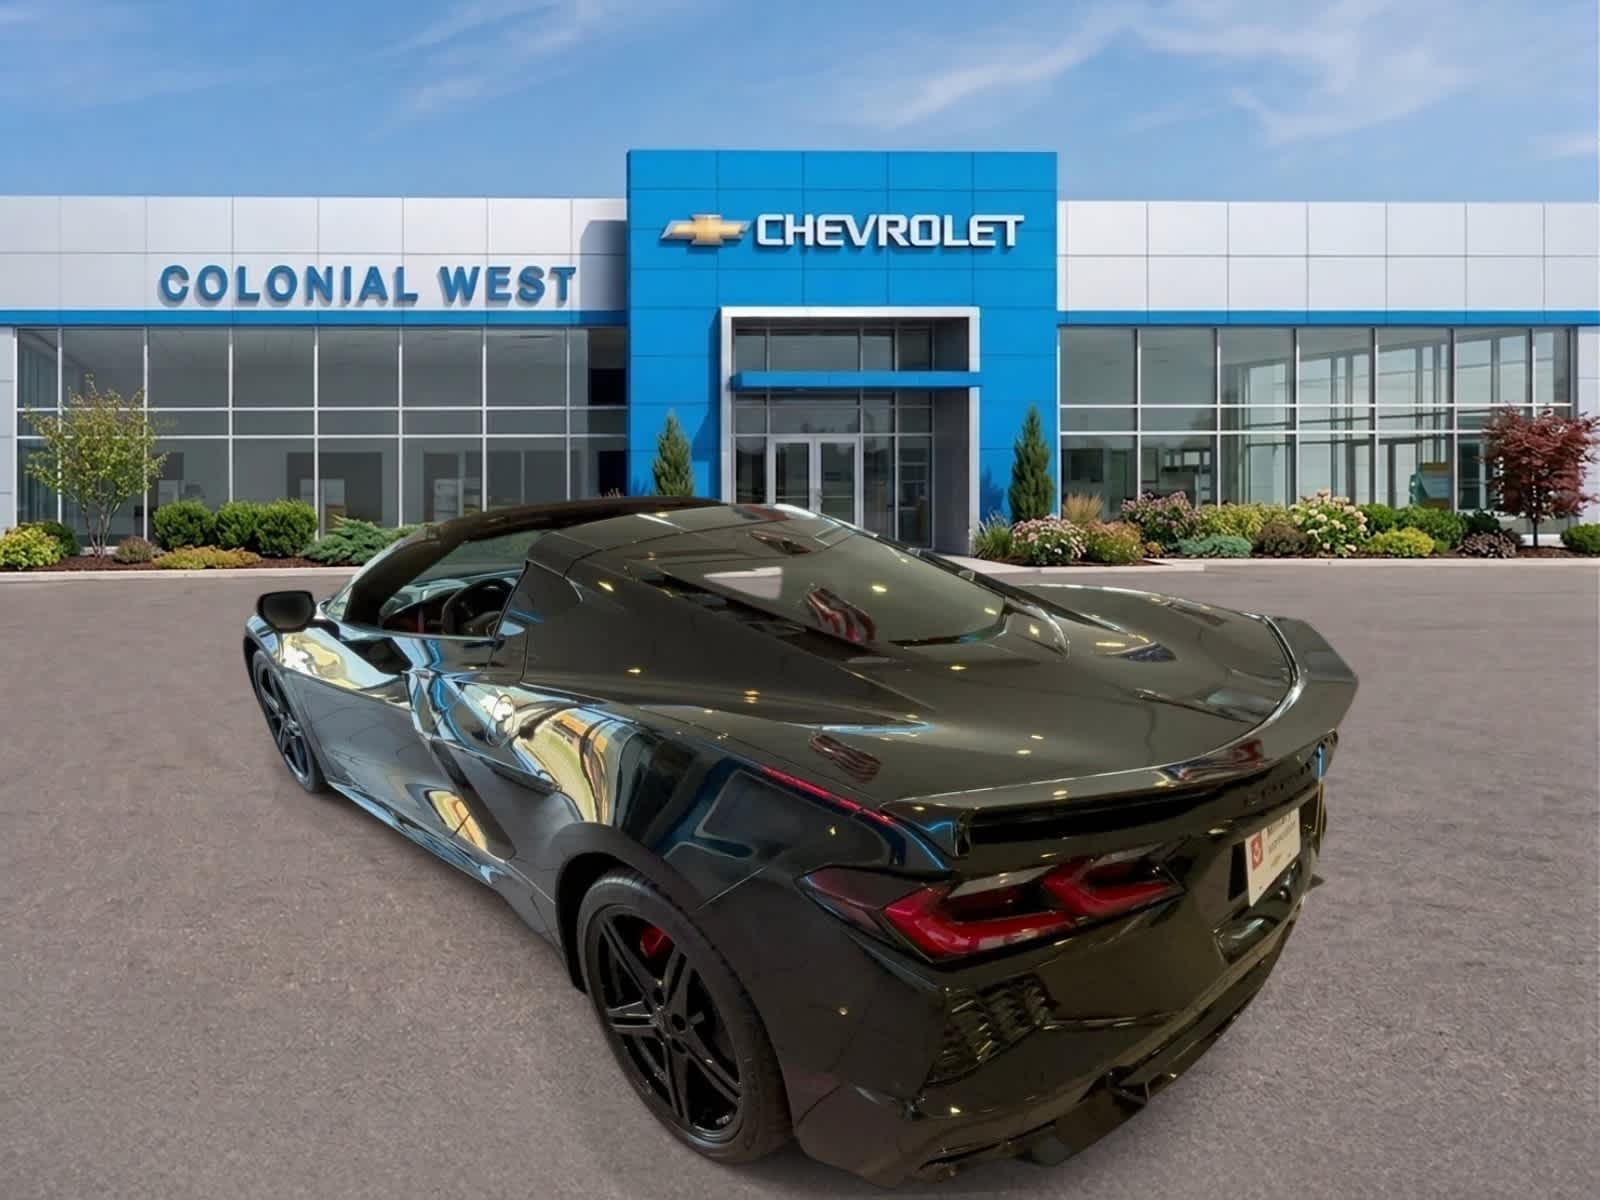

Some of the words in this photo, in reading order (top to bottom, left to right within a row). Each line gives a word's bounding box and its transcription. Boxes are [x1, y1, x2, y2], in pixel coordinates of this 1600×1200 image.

[757, 213, 1025, 247] CHEVROLET
[160, 264, 418, 303] COLONIAL
[438, 264, 577, 303] WEST
